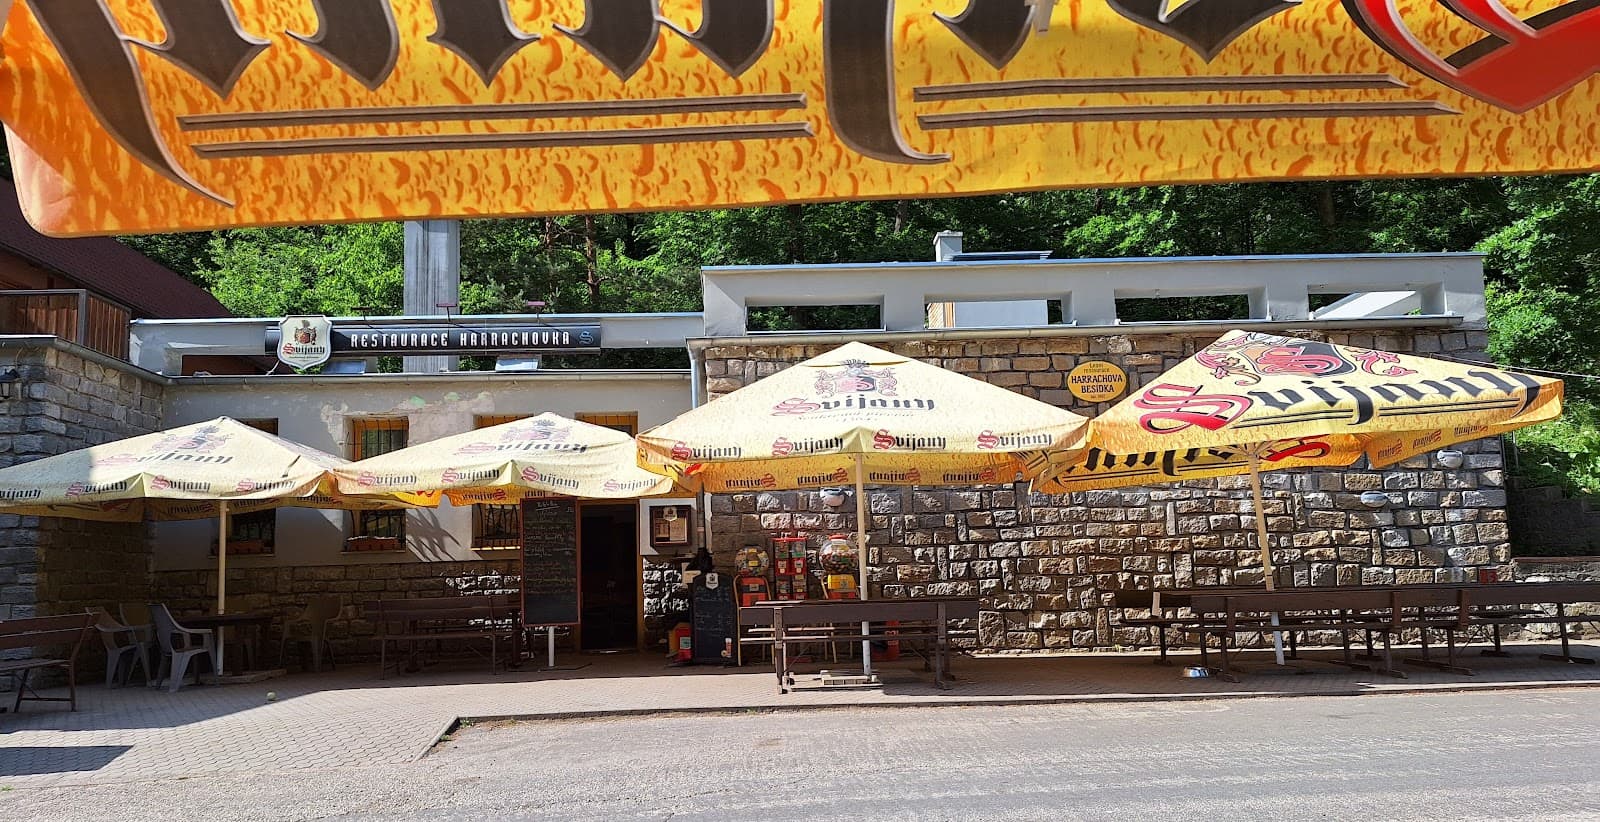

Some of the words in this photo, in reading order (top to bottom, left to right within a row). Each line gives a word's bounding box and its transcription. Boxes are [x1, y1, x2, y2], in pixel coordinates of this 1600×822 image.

[282, 342, 326, 355] Svijany
[350, 332, 449, 348] RESTAURACE
[459, 331, 571, 347] HARRACHOVKA
[1071, 374, 1123, 384] HARRACHOVA
[770, 393, 935, 417] Svijany
[1133, 370, 1541, 434] Svijany
[772, 436, 844, 457] Svijany
[873, 429, 946, 451] Svijany
[976, 429, 1053, 450] Svijany
[671, 440, 742, 460] Svijany
[150, 474, 211, 493] Svijany
[357, 470, 417, 487] Svijany
[441, 467, 500, 484] Svijany
[520, 465, 580, 490] Svijany
[602, 477, 657, 493] Svijany
[0, 487, 42, 501] vijany
[65, 480, 128, 499] Svijany
